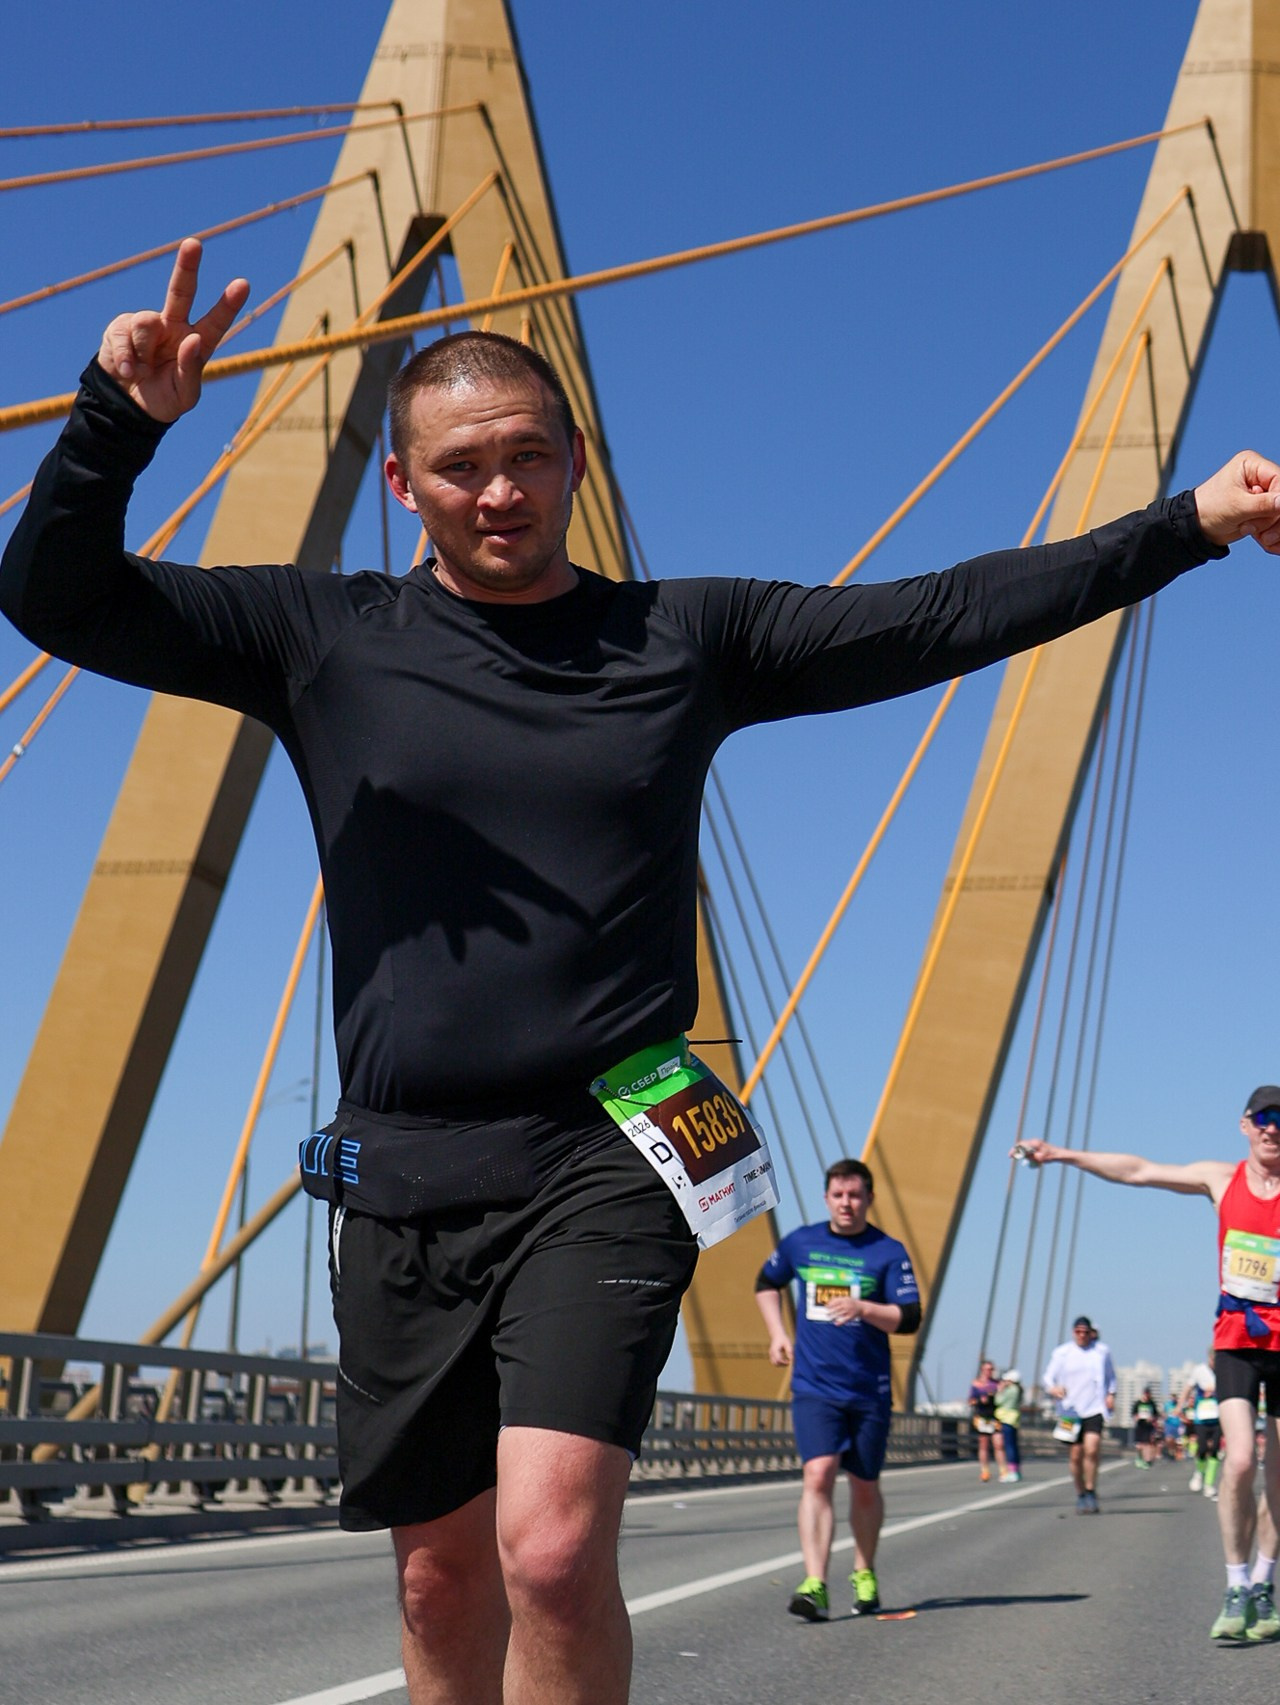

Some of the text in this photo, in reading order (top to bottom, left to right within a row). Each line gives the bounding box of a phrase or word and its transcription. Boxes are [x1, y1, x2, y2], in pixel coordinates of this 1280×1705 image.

[631, 1072, 657, 1091] СБЕР
[627, 1119, 651, 1138] 2026
[671, 1092, 746, 1160] 15839
[649, 1141, 674, 1165] D
[708, 1182, 736, 1206] МАГНИТ
[1238, 1256, 1268, 1277] 1796
